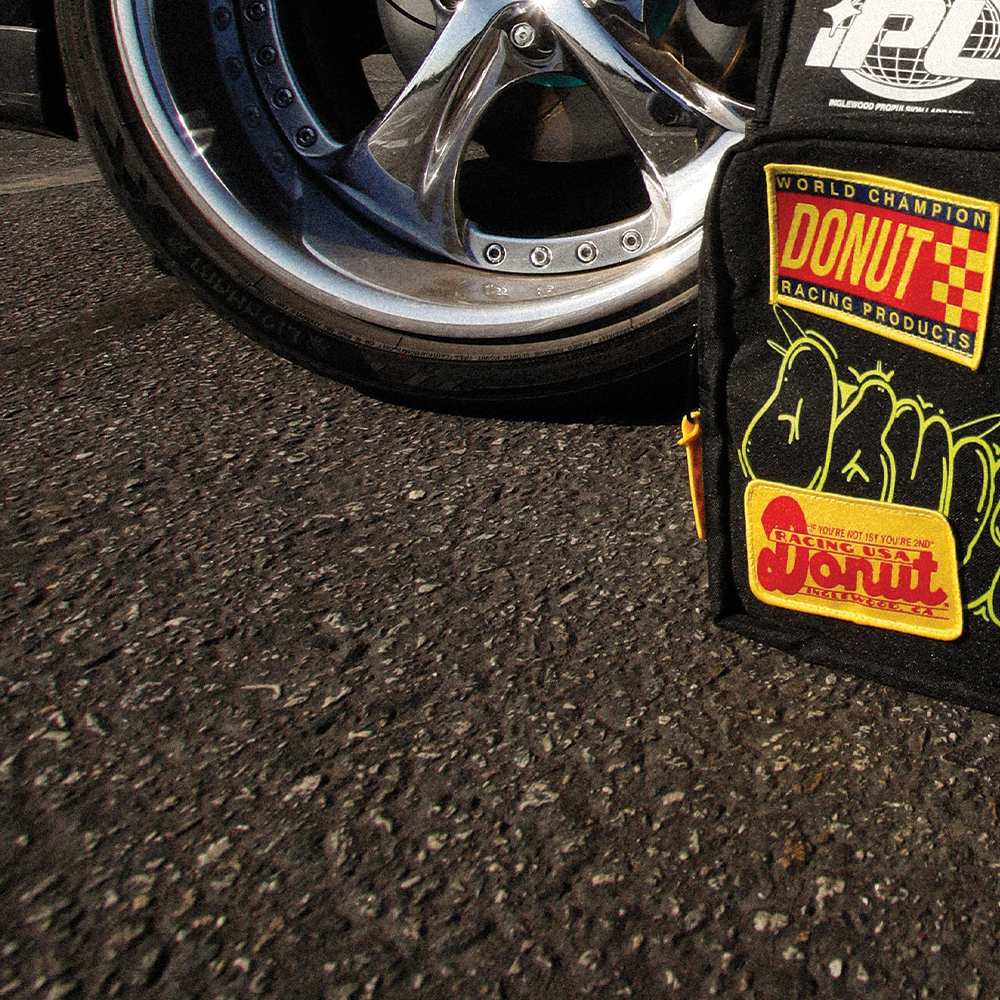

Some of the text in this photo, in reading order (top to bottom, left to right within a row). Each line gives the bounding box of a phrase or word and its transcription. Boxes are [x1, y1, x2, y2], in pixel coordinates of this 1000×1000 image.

[828, 98, 875, 110] INGLEWOOD
[776, 177, 987, 228] WORLD CHAMPION
[780, 202, 935, 300] DONUT
[780, 279, 970, 349] RACING PRODUCTS
[774, 530, 910, 562] RACING USA
[819, 525, 845, 538] YOU'RE
[847, 529, 863, 540] NOT
[865, 532, 879, 542] 1ST
[881, 534, 912, 546] YOU'RE
[911, 605, 933, 615] CA
